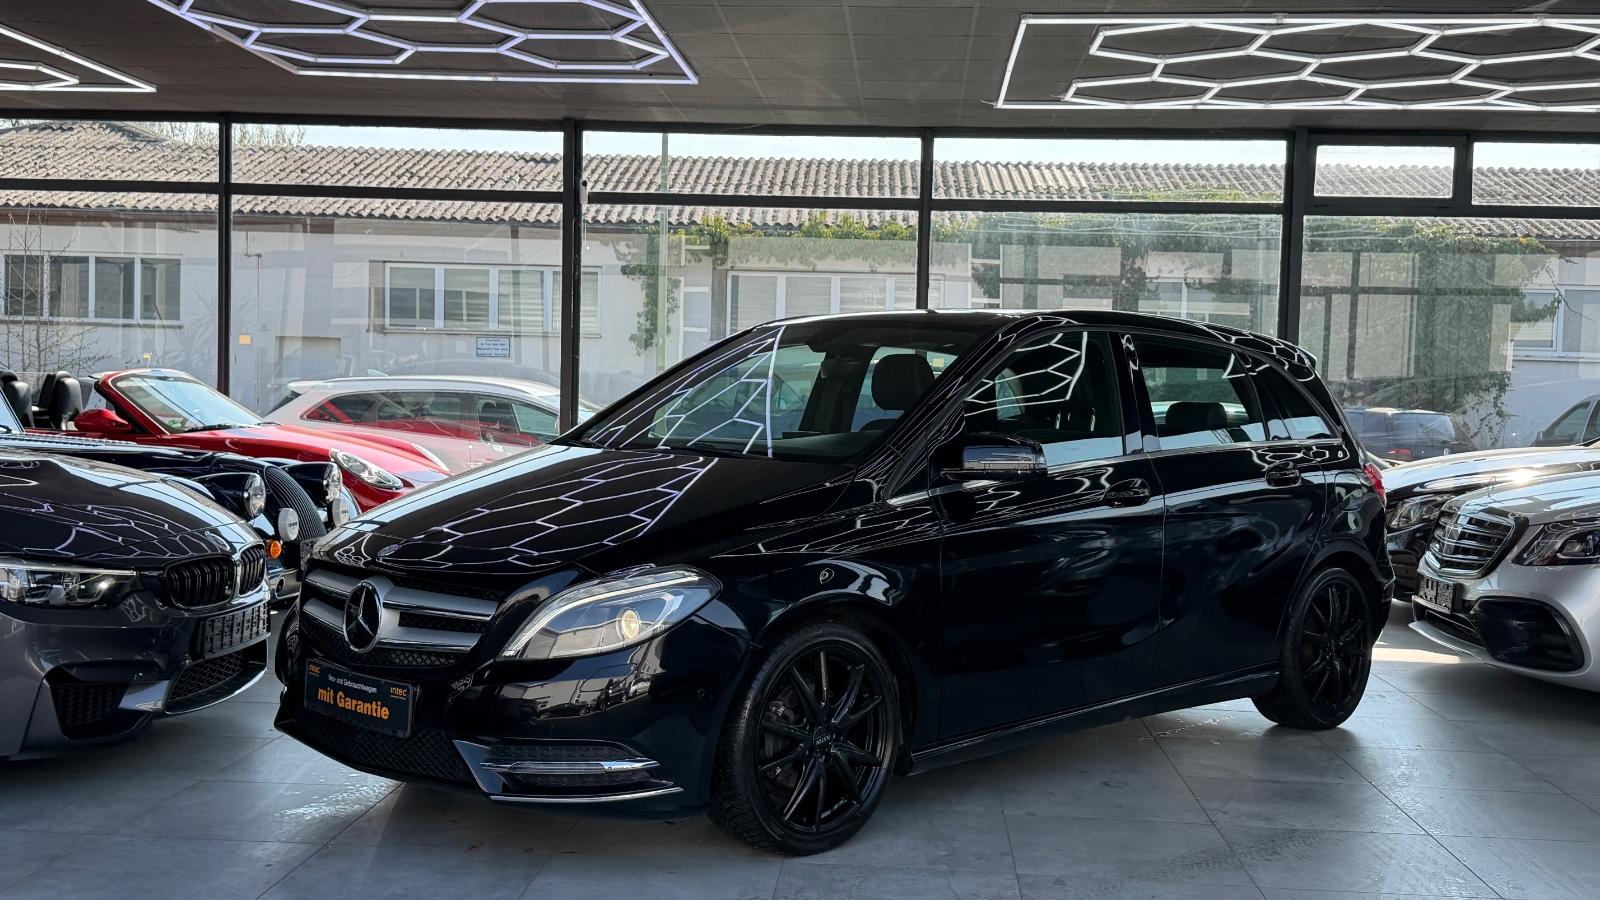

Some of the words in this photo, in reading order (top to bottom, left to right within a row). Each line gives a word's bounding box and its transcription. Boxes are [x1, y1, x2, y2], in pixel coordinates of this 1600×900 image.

[344, 679, 378, 693] Gebrauchtwagen
[390, 687, 407, 697] intec
[318, 687, 335, 705] mit
[336, 691, 390, 720] Garantie
